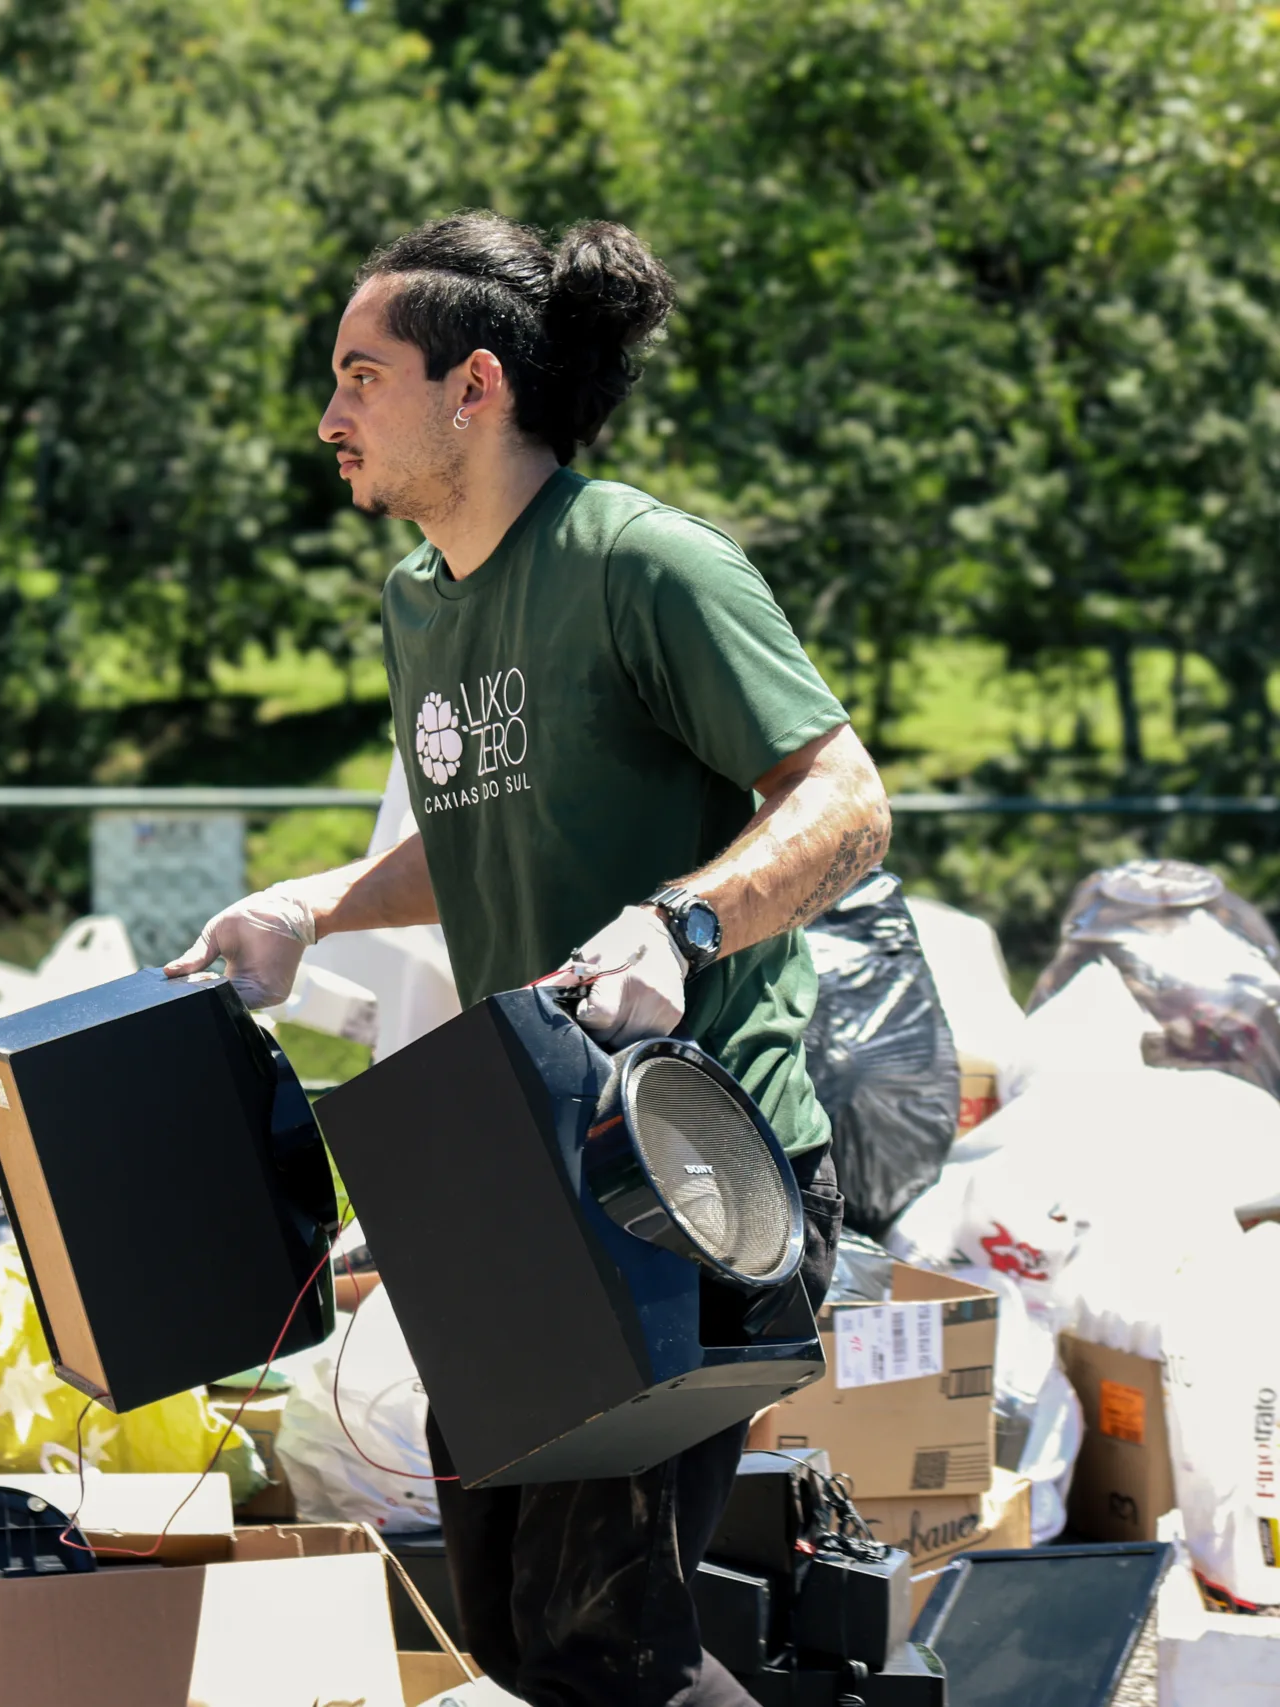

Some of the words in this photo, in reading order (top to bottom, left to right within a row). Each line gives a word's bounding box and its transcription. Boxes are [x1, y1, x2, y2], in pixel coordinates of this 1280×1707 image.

[459, 666, 526, 728] LIXO
[470, 716, 528, 776] ZERO
[424, 785, 480, 814] CAXIAS
[483, 781, 500, 800] DO
[506, 772, 531, 793] SUL
[684, 1165, 714, 1174] SONY
